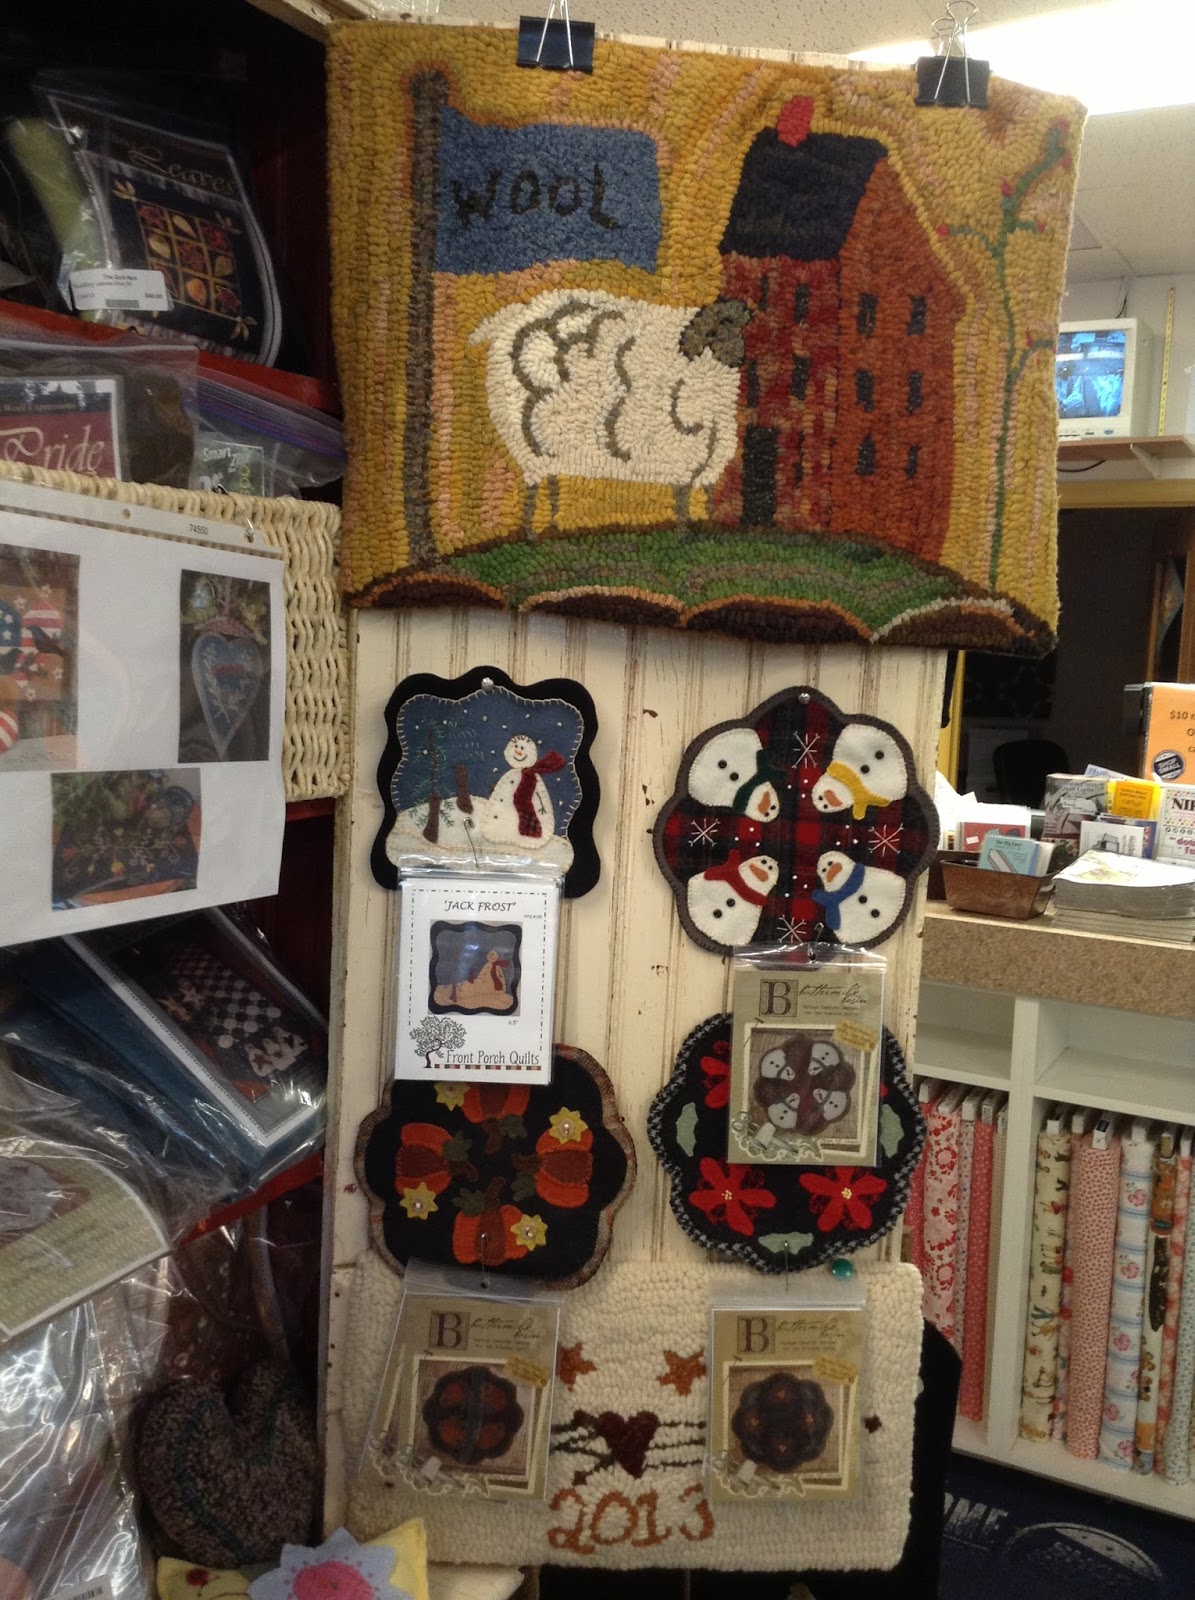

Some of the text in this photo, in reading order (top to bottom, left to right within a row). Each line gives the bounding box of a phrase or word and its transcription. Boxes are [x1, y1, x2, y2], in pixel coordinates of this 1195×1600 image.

[451, 162, 621, 231] WOOL
[0, 424, 105, 475] Pride
[203, 447, 232, 462] Smart
[1170, 710, 1188, 720] $10
[761, 980, 792, 1016] B
[446, 1050, 540, 1066] Front Porch Quilts
[432, 1313, 462, 1348] B
[740, 1318, 770, 1353] B
[547, 1482, 716, 1554] 2013
